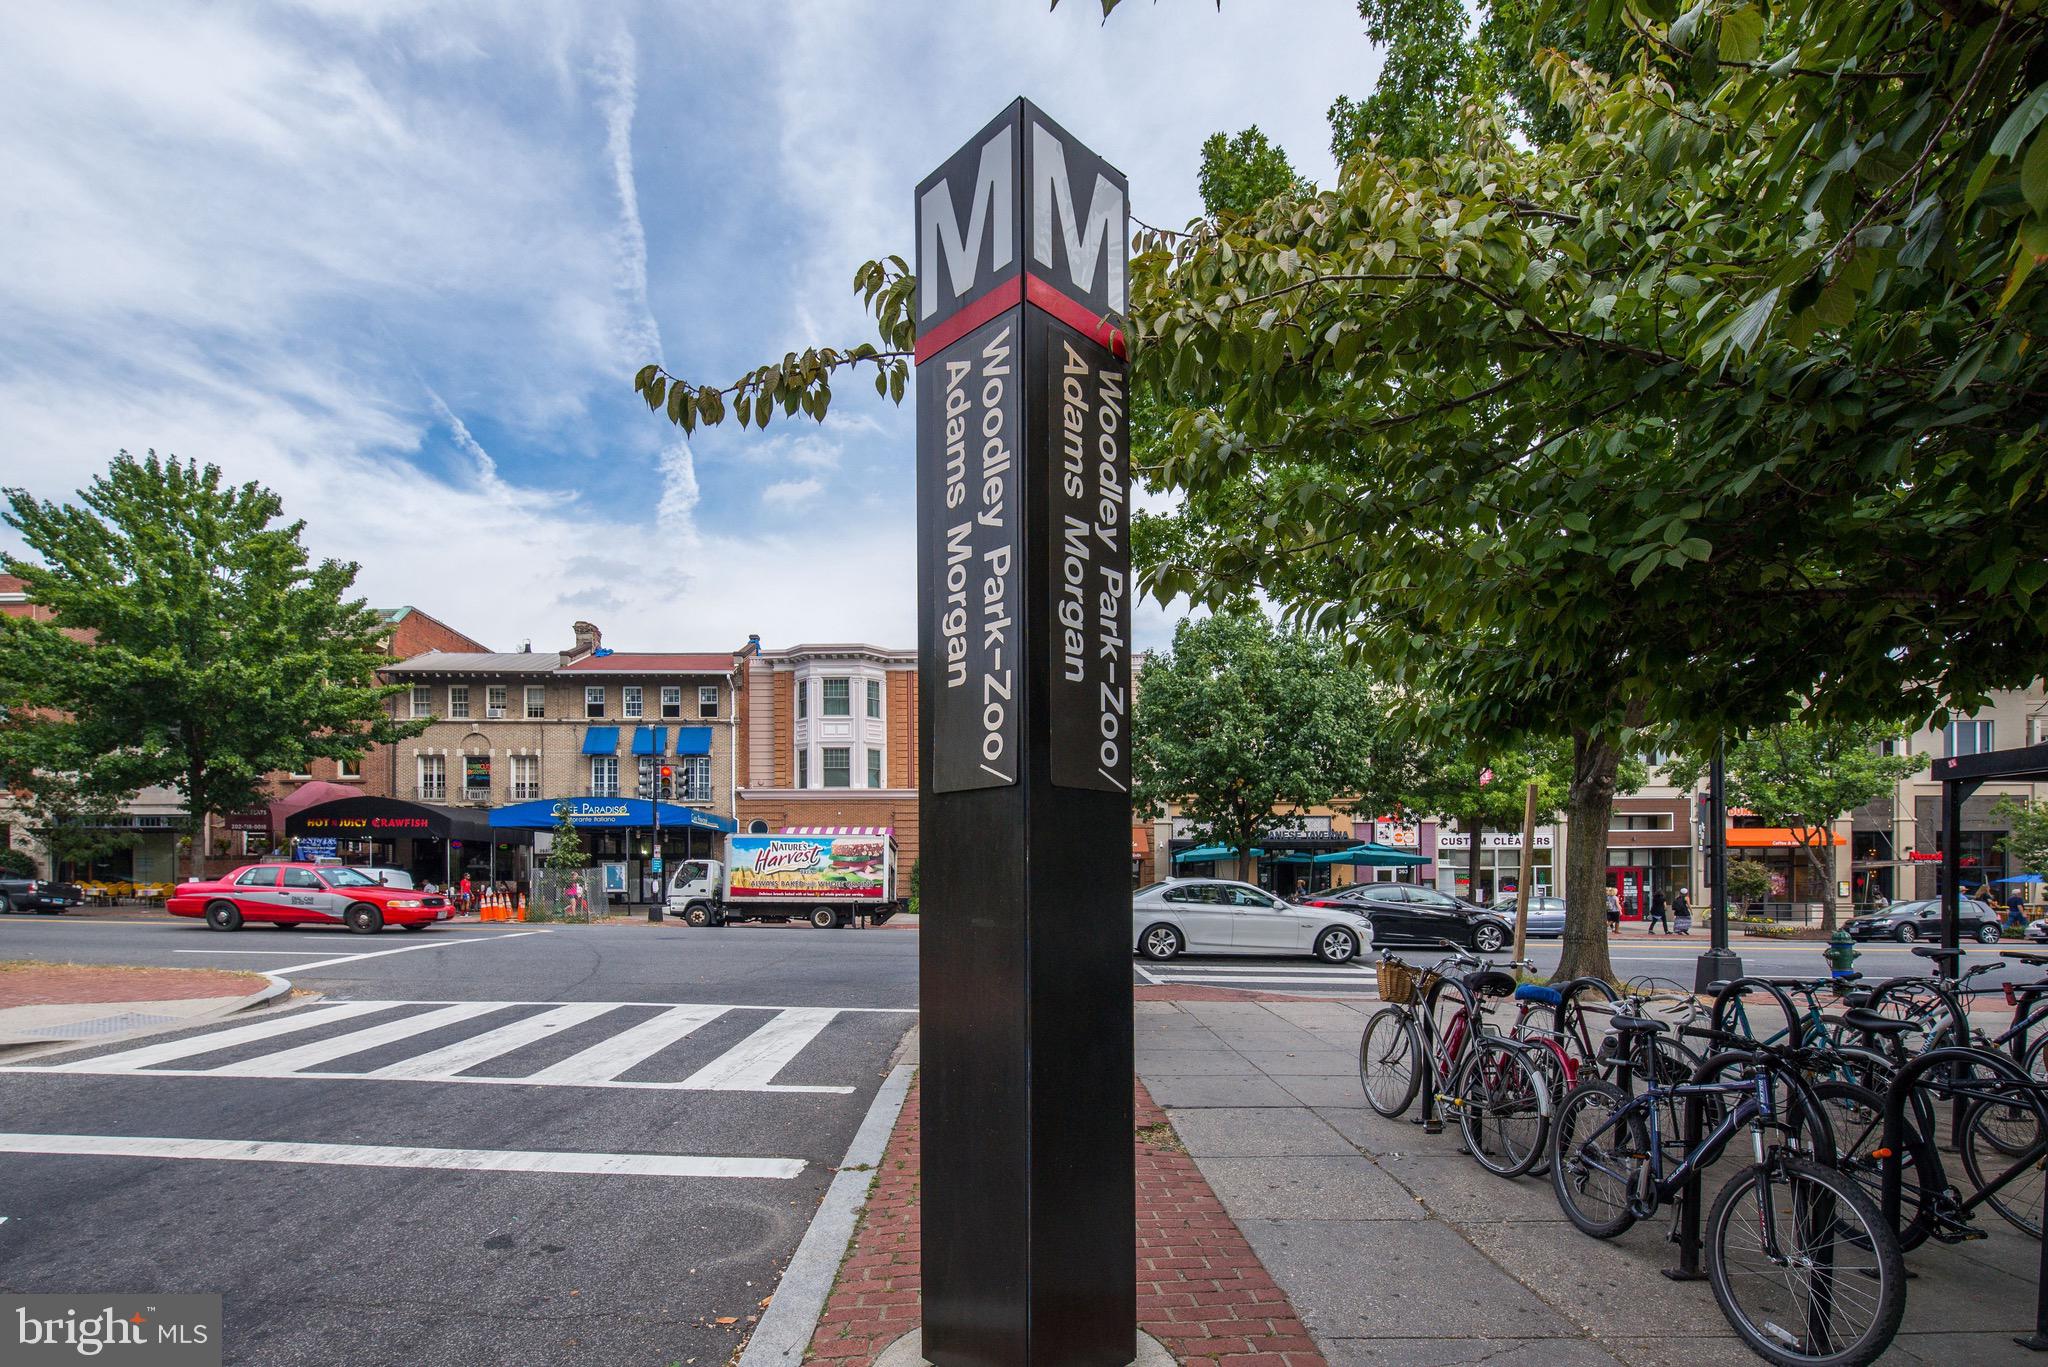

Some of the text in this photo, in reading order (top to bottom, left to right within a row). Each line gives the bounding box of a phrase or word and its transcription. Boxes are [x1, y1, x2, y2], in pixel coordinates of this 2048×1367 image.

[921, 124, 1013, 321] M
[1033, 121, 1124, 316] M
[978, 326, 1010, 527] Woodley
[1058, 340, 1090, 683] Adams Morgan
[1095, 370, 1123, 552] Woodley
[942, 361, 973, 688] Adams Morgan
[307, 819, 328, 827] HOT
[339, 819, 367, 827] JUICY
[371, 817, 429, 827] CRAWFISH
[751, 880, 779, 888] ALWAYS
[780, 880, 805, 888] BAKED
[754, 845, 822, 872] Harvest
[771, 842, 808, 852] NATURE'S
[1441, 837, 1550, 845] CUSTM CLEAERS
